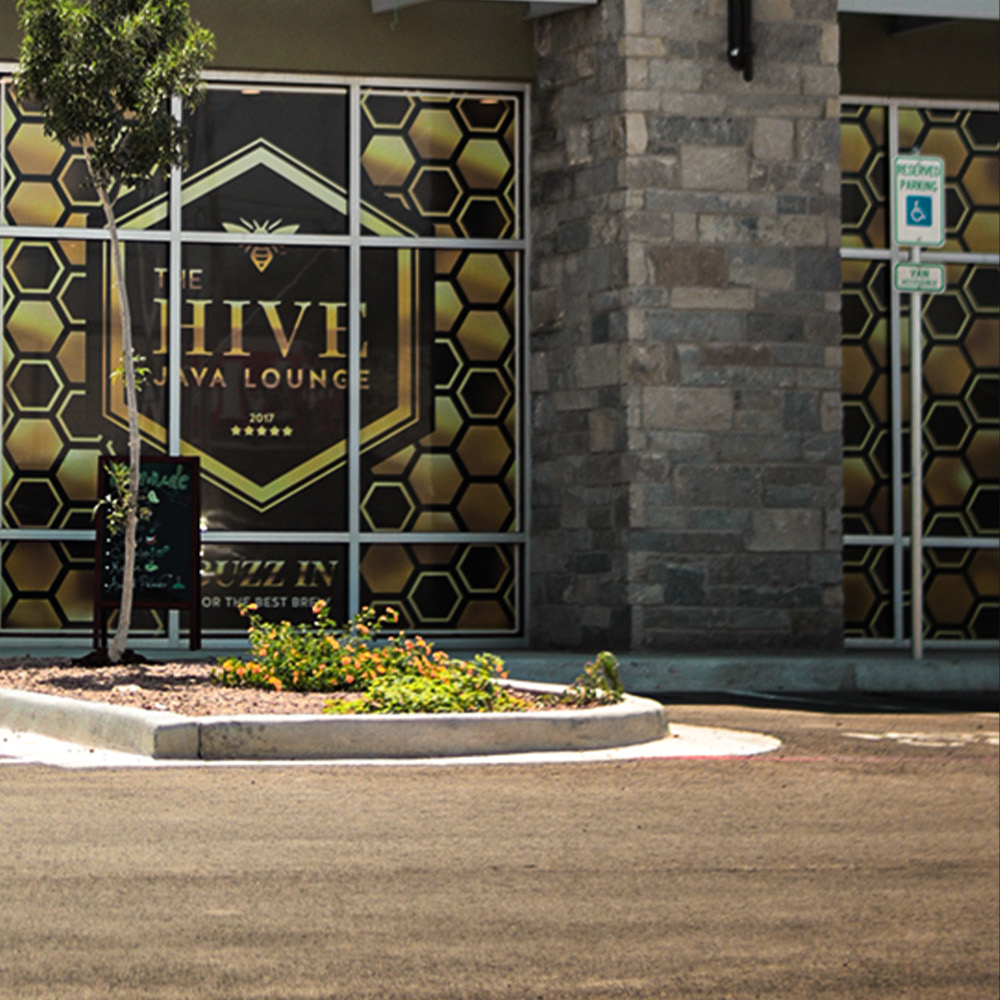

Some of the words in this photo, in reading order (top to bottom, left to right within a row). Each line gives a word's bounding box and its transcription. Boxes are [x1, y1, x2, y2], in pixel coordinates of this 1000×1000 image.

[897, 164, 941, 178] RESERVED
[900, 179, 938, 192] PARKING
[910, 269, 930, 278] VAN
[153, 298, 368, 359] HIVE
[244, 367, 371, 390] LOUNGE
[249, 412, 275, 423] 2017
[294, 560, 339, 588] IN
[257, 596, 287, 608] BEST
[292, 596, 331, 609] BRE
